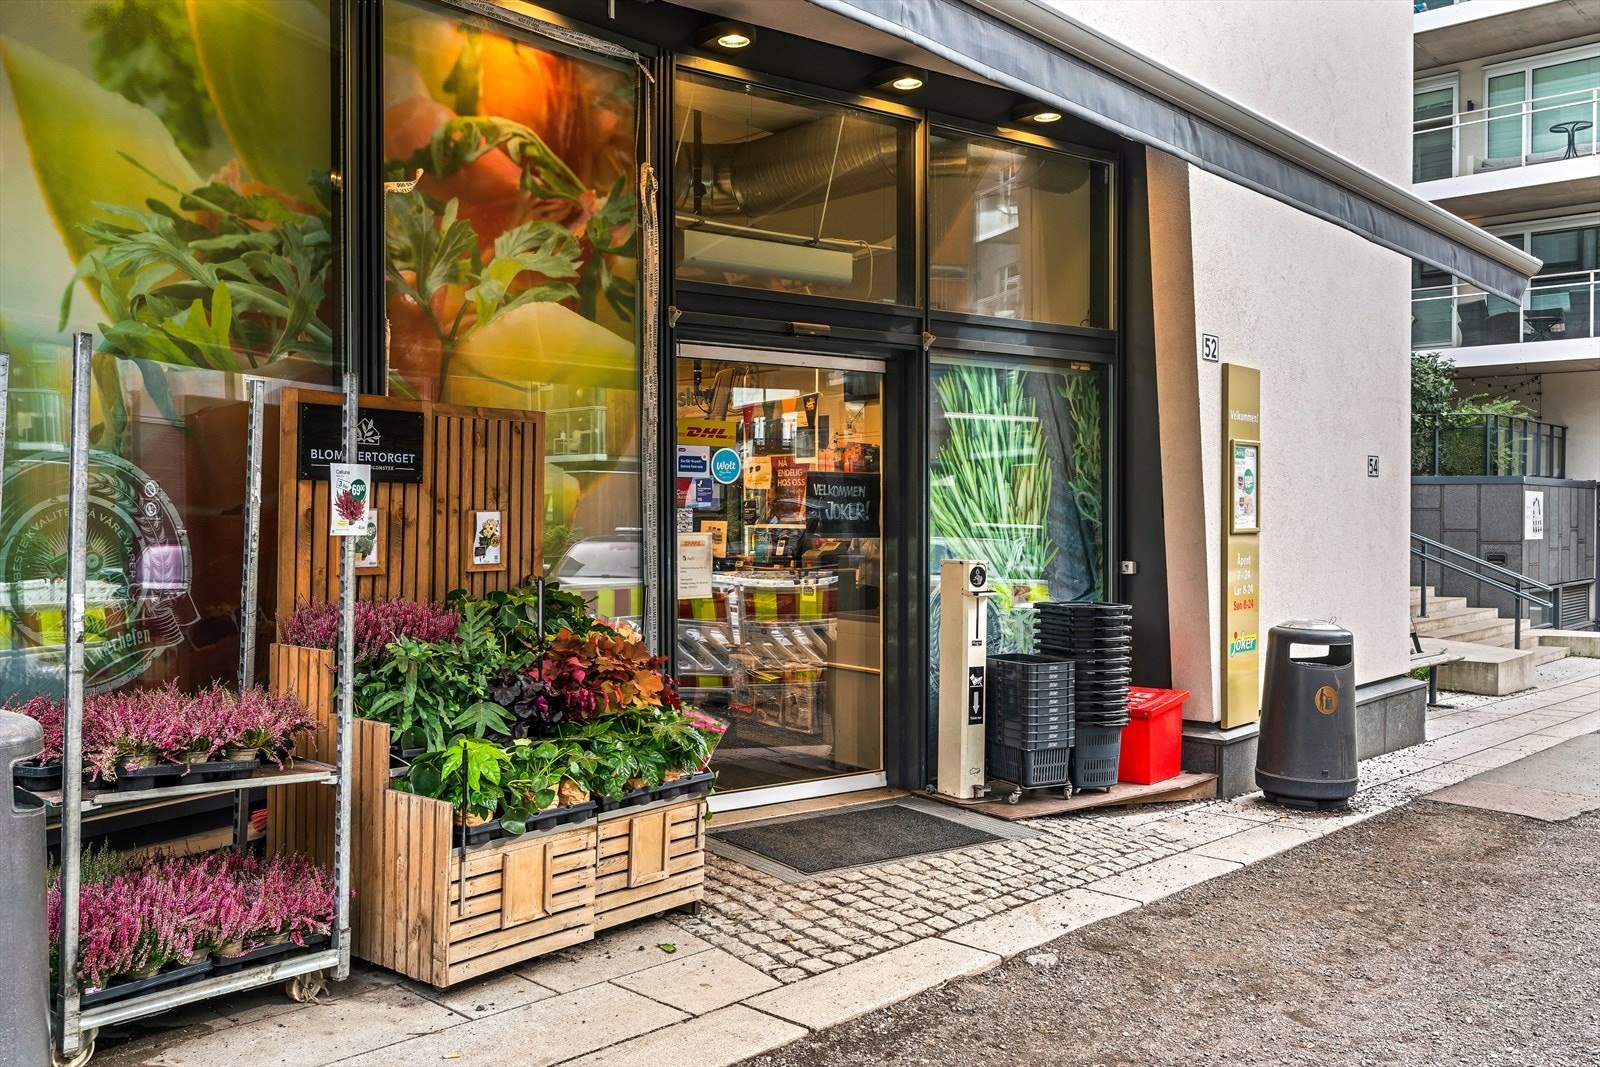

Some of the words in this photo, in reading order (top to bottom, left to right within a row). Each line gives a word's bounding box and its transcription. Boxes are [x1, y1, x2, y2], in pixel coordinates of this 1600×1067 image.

[1205, 338, 1216, 358] 52
[1230, 410, 1259, 423] Velkommen!
[686, 426, 730, 439] DHL
[310, 448, 416, 464] BLOMERTORGET
[778, 457, 787, 467] NÅ
[716, 461, 736, 470] Wolt
[1370, 459, 1377, 474] 54
[778, 468, 803, 477] ENDELIG
[814, 484, 866, 497] VELKOMMEN
[825, 501, 870, 521] JOKER!
[13, 539, 29, 581] BESTE
[26, 508, 69, 540] KVALITE
[100, 512, 126, 538] VÅRE
[123, 538, 138, 579] VARER
[1237, 552, 1251, 567] Åpent
[1244, 570, 1251, 580] 24
[1243, 584, 1254, 595] 8-24
[1243, 599, 1254, 610] 8-24
[1230, 632, 1254, 657] joker
